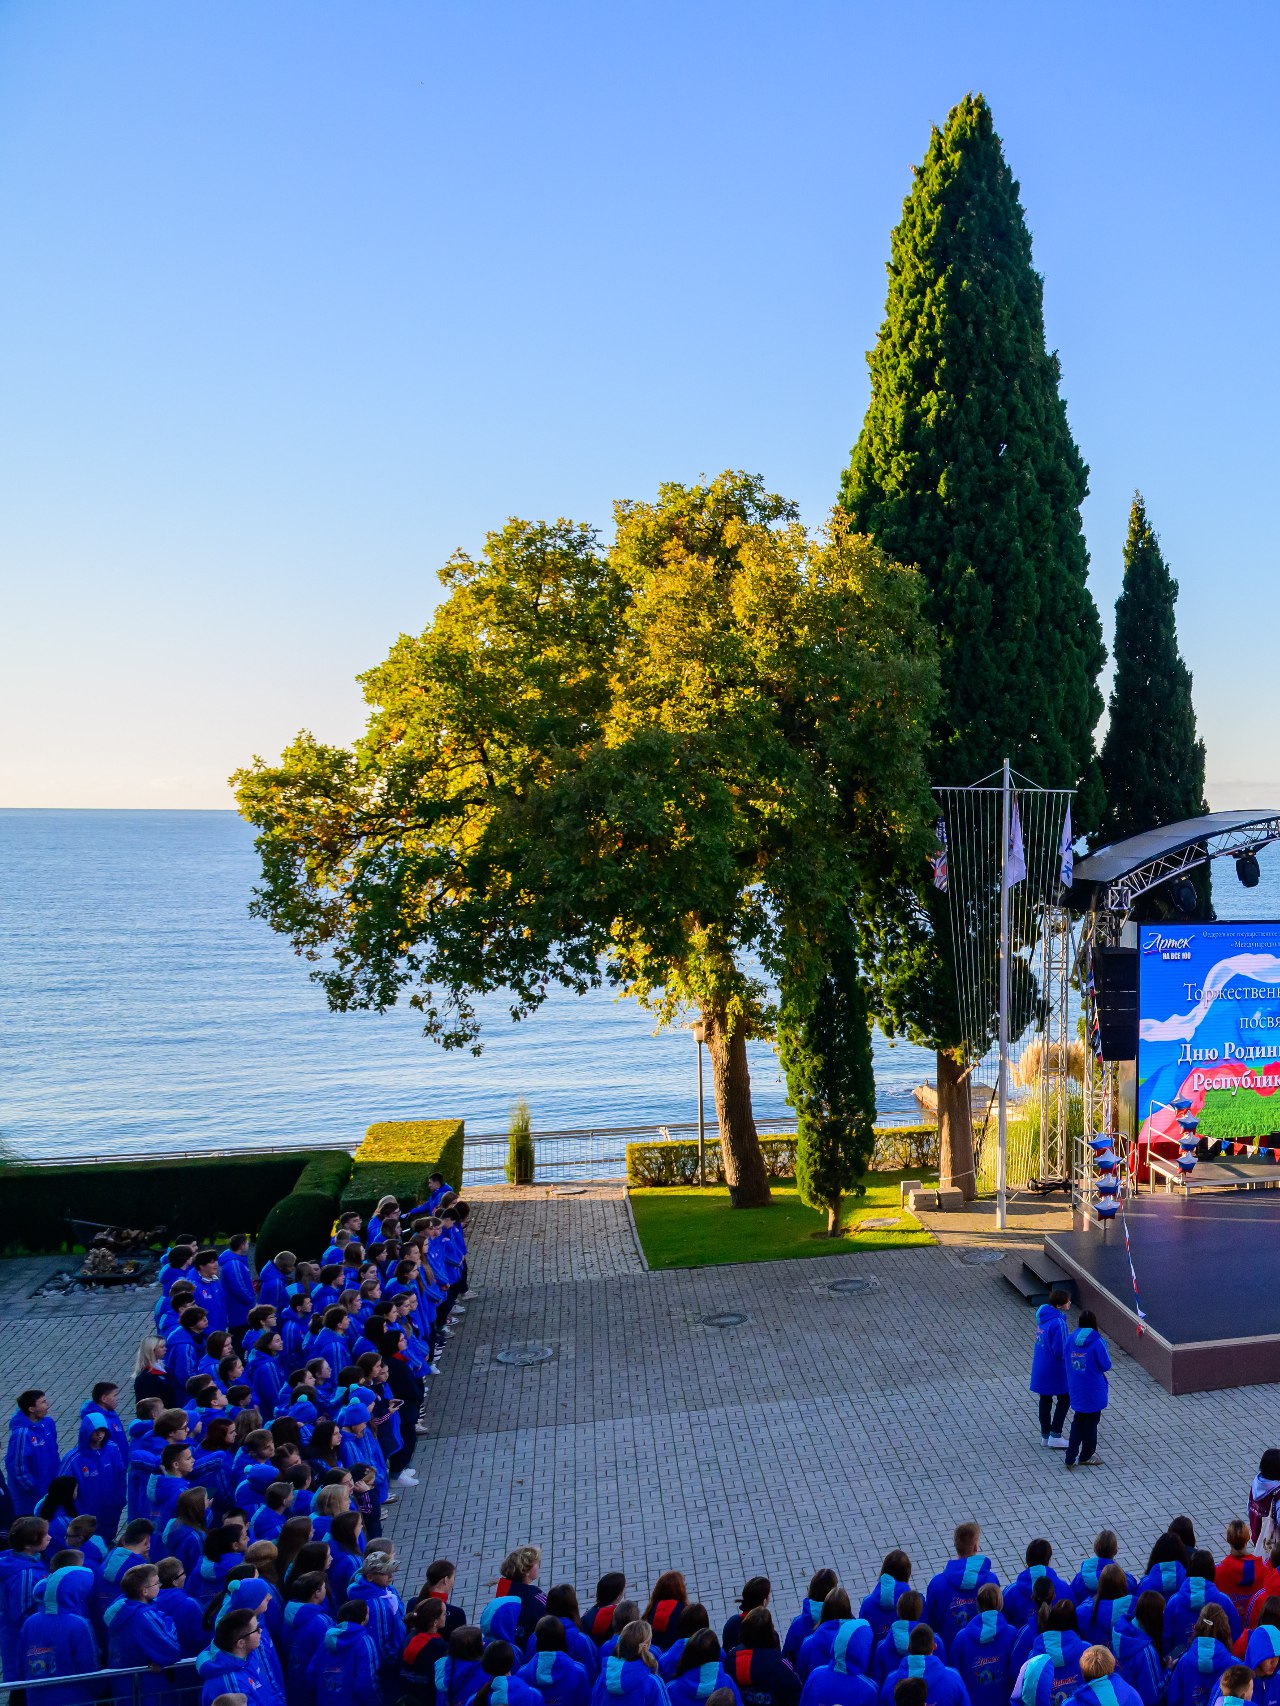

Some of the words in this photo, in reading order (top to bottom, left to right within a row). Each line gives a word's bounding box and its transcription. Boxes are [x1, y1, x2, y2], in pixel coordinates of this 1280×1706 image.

[1142, 932, 1196, 953] Артек
[1162, 952, 1170, 960] НА
[1171, 952, 1181, 960] ВСЕ
[1178, 1043, 1219, 1065] Дню
